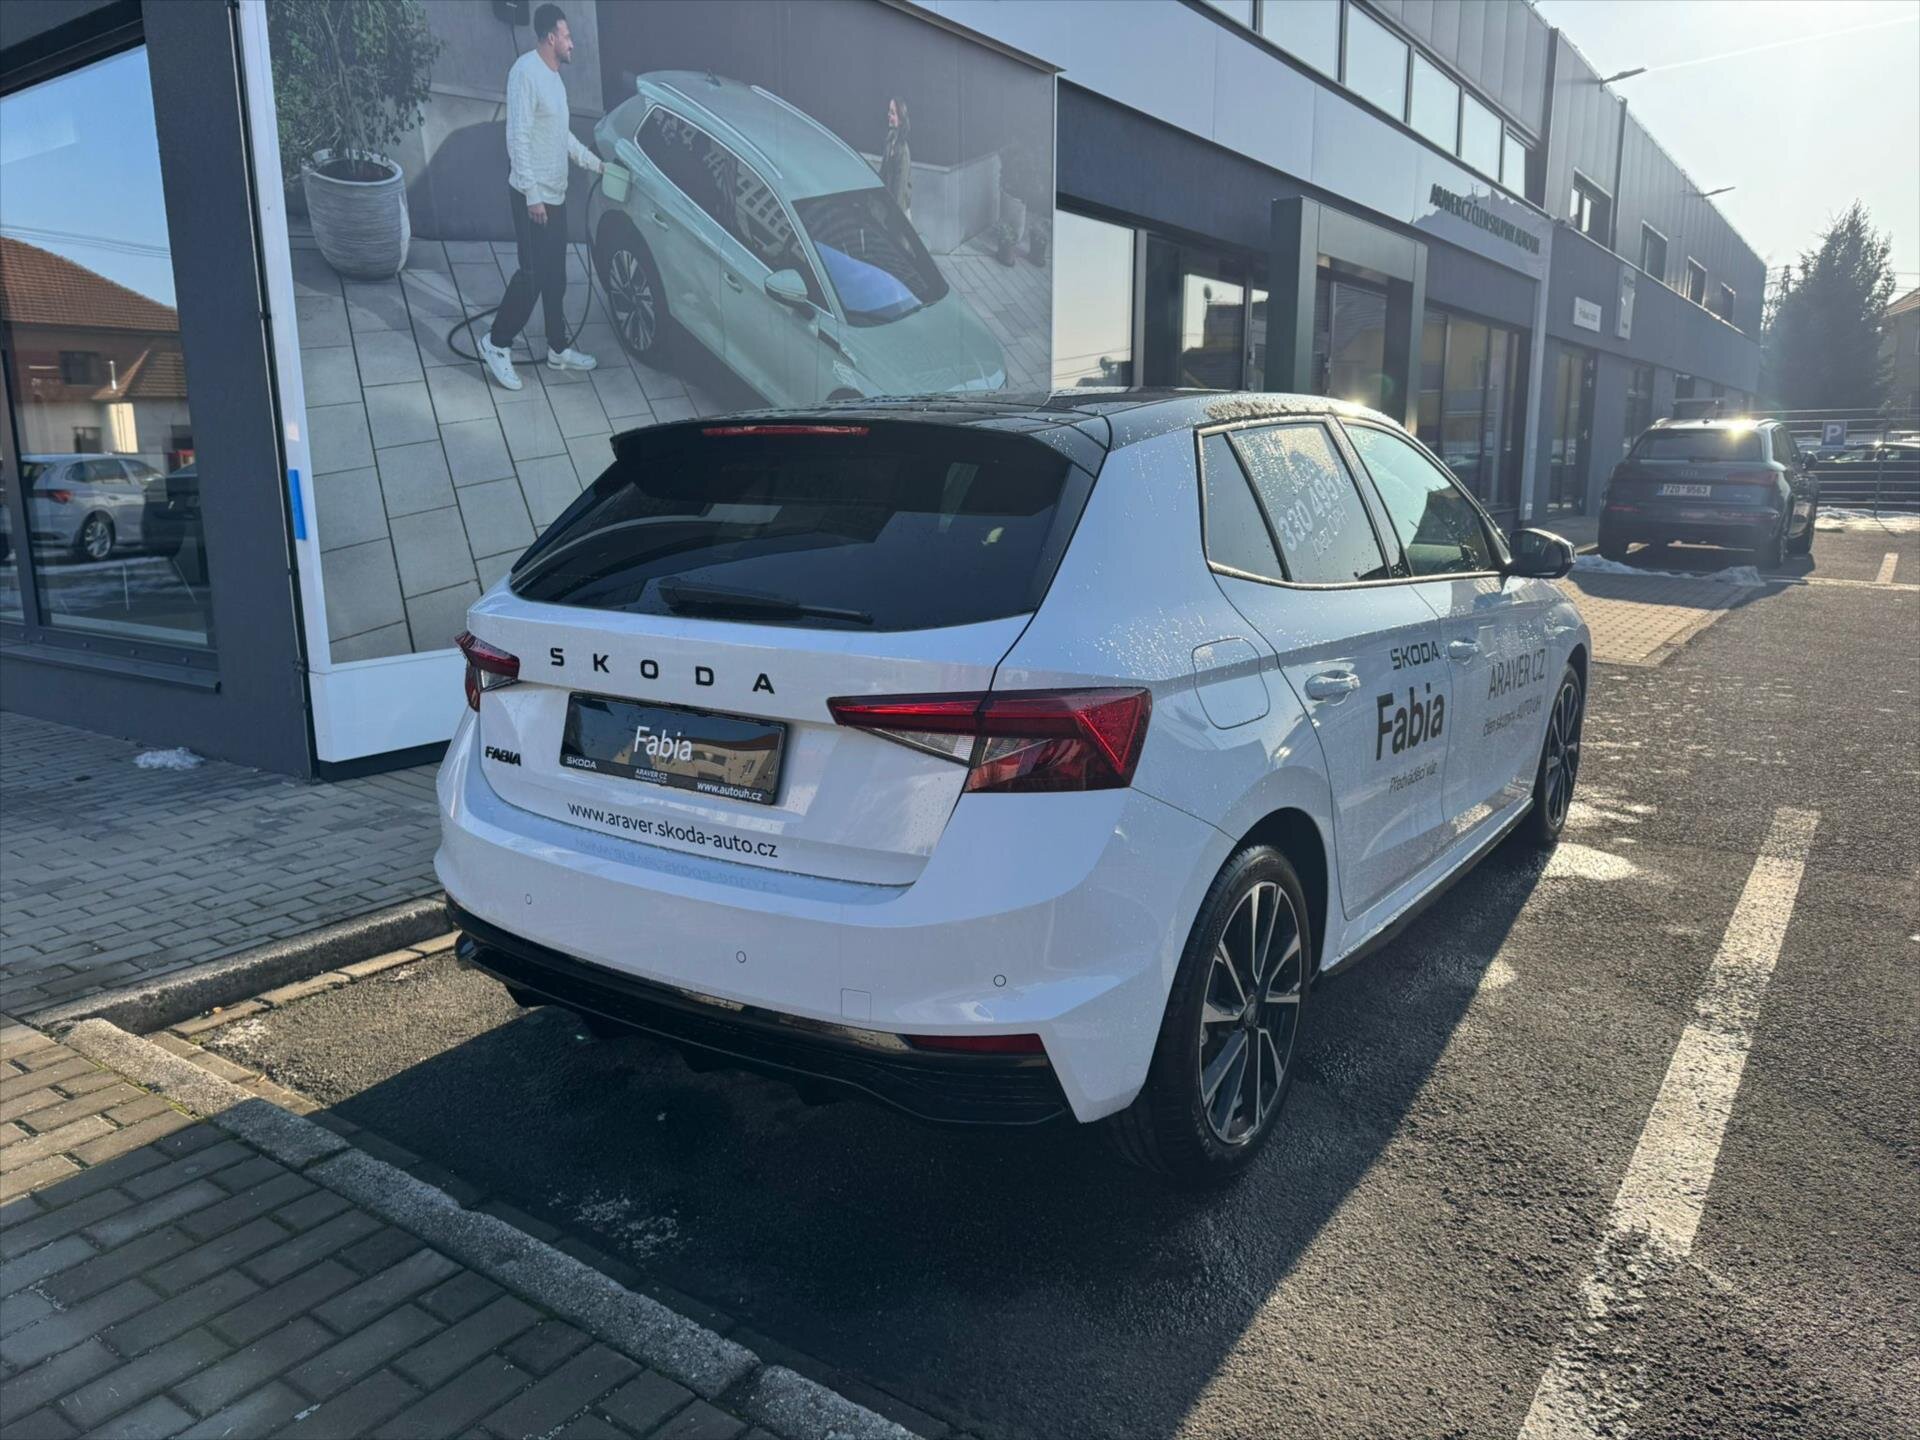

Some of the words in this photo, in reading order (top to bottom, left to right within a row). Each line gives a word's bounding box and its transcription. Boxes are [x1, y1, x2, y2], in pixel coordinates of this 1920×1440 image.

[1825, 424, 1842, 442] P
[1487, 653, 1531, 701] ARAVER
[1376, 682, 1445, 762] Fabia
[485, 745, 522, 767] FABIA
[633, 725, 693, 761] Fabia
[697, 781, 763, 801] www.autouh.cz
[567, 801, 779, 859] www.araver.skoda-auto.cz
